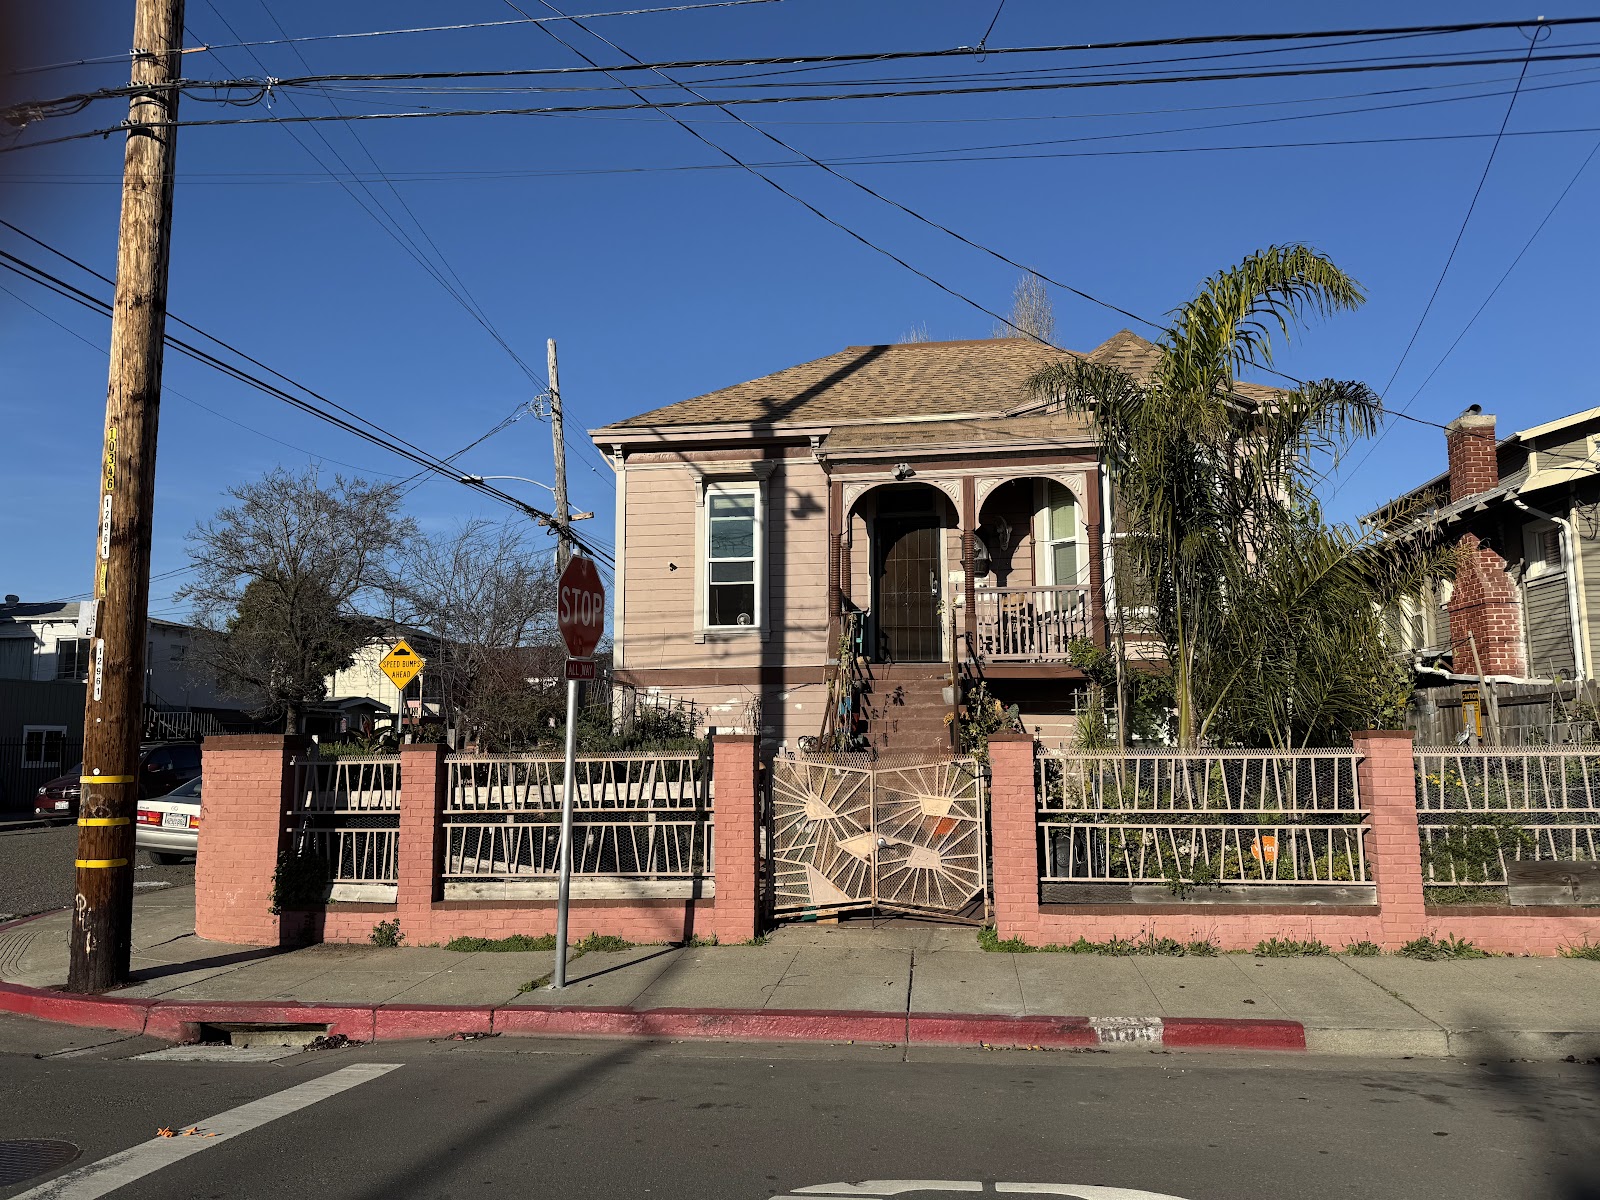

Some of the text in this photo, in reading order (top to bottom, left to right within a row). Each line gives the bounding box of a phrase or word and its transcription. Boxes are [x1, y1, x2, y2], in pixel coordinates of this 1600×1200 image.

[106, 428, 116, 490] 10346
[561, 586, 603, 628] STOP
[383, 660, 420, 668] SPEED BUMPS
[568, 664, 593, 676] ALL WAY
